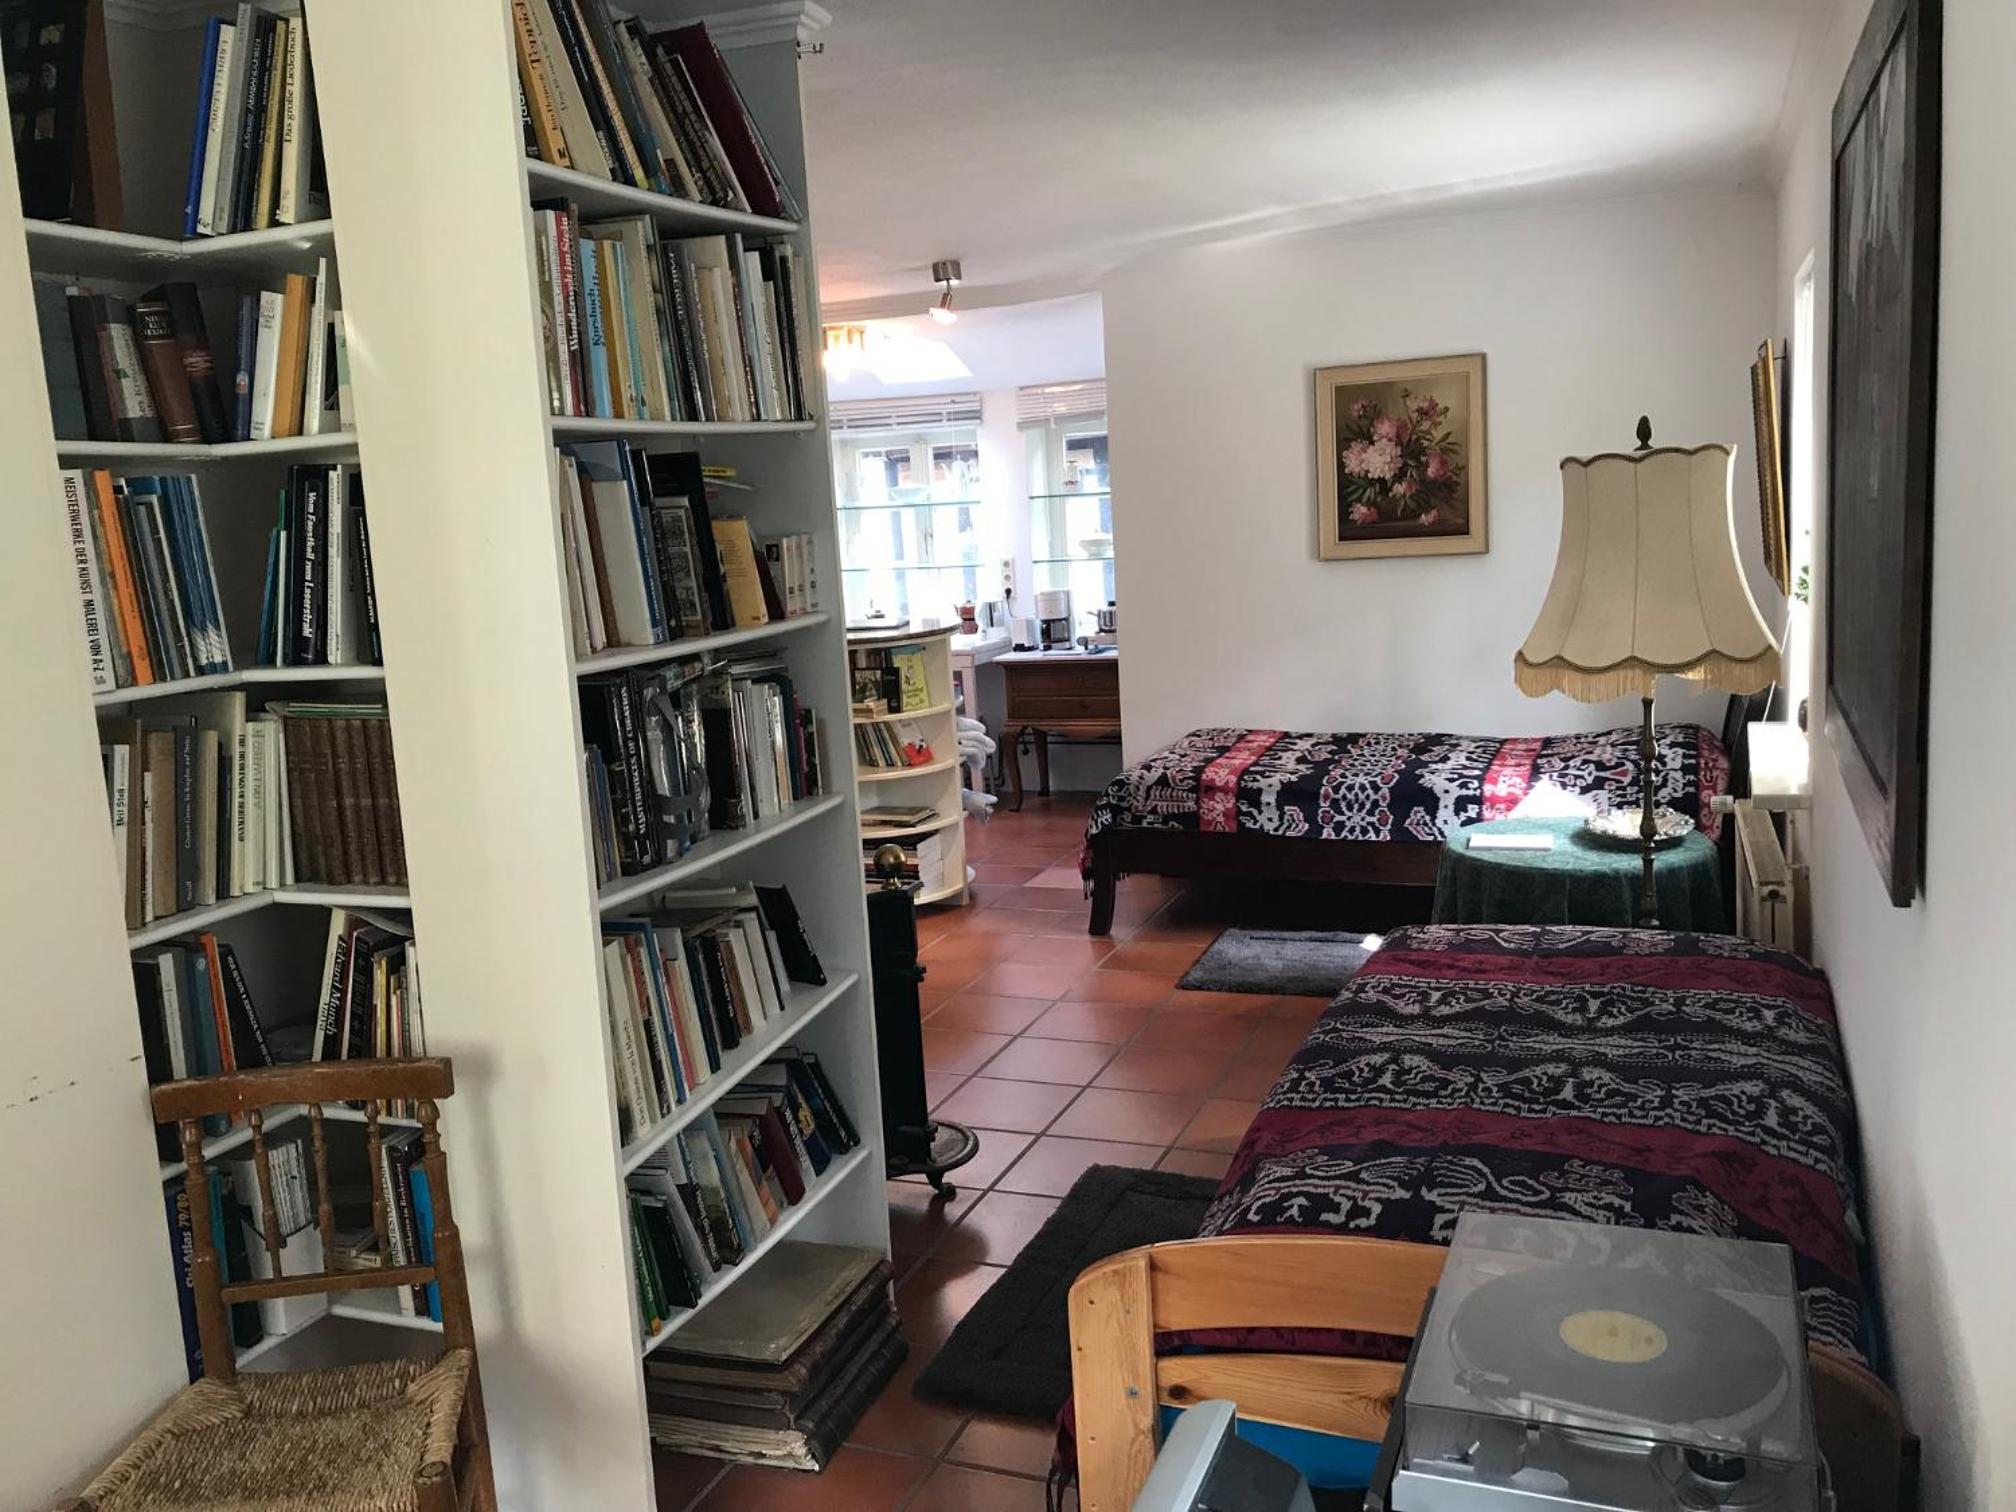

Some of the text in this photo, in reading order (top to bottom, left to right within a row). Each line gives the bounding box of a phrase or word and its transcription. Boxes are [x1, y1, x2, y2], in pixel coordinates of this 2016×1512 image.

[282, 26, 298, 142] Das große Liederbuch
[557, 215, 570, 252] Stein
[562, 252, 573, 270] im
[562, 271, 579, 351] Wunderwelt
[585, 287, 603, 346] Kursbuch
[61, 475, 85, 546] MEISTERWERKE
[73, 545, 88, 565] DER
[301, 490, 317, 638] Vom Faustkeil zum Laserstrahl
[76, 565, 93, 596] KUNST
[81, 597, 100, 637] MALEREI
[88, 637, 103, 657] VON
[90, 656, 105, 673] A-Z
[237, 733, 245, 747] THE
[619, 684, 648, 835] MASTERPIECES OF CREATION
[237, 750, 245, 789] DRAWINGS
[237, 800, 245, 842] REMBRANDT
[330, 939, 350, 988] Edvard
[324, 988, 343, 1036] Munch
[179, 1230, 194, 1264] Atlas
